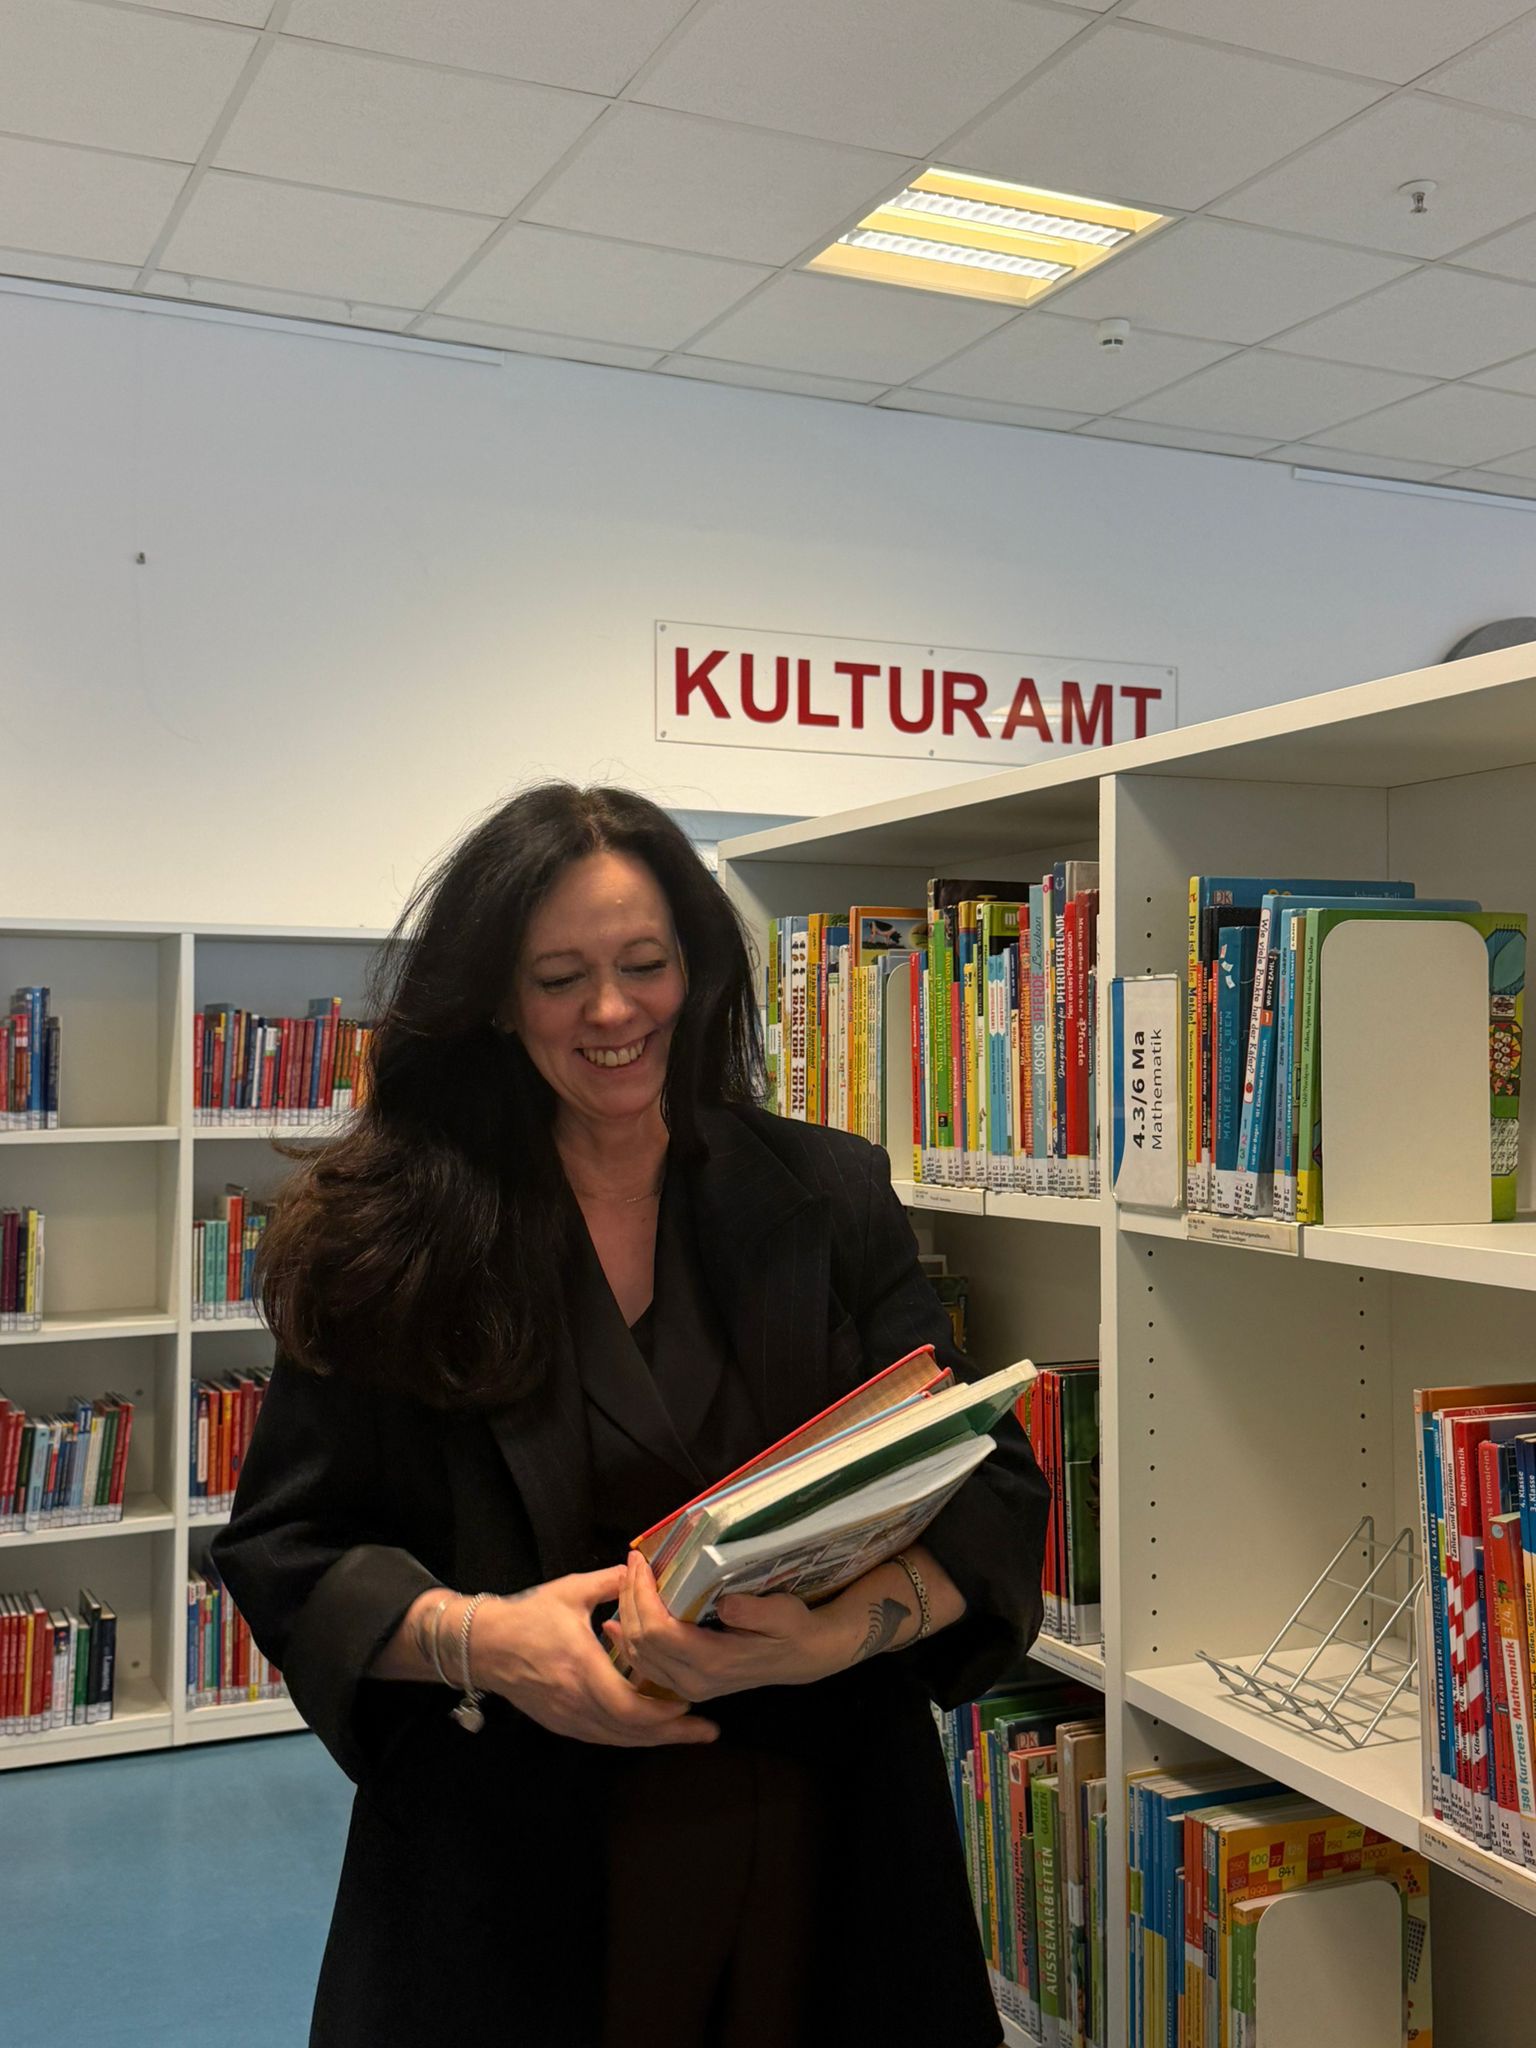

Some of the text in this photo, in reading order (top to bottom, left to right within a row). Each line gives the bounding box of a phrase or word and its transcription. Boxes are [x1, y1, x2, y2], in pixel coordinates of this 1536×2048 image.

[674, 646, 1163, 747] KULTURAMT
[1213, 890, 1233, 905] DK
[1032, 915, 1043, 970] Lexikon
[1188, 915, 1197, 936] Das
[1055, 912, 1066, 1004] PFERDEFREUNDE
[1065, 930, 1073, 975] Pferdebuch
[1188, 958, 1197, 983] alles
[1032, 975, 1045, 1022] PFERDE
[1187, 986, 1197, 1025] Mathe!
[1247, 918, 1269, 1074] Wie viele Punkte hat der Käfer?
[935, 973, 943, 1072] Mein Pferd und ich
[1077, 1017, 1087, 1067] Pferde
[791, 985, 799, 1114] TRAKTOR TOTAL
[1033, 1024, 1046, 1075] KOSMOS
[1131, 1031, 1148, 1150] 4.3/6 Ma
[1150, 1028, 1163, 1150] Mathematik
[1222, 1056, 1232, 1090] FÜRS
[1223, 1095, 1232, 1140] MATHE
[1446, 1463, 1455, 1513] Operationen
[1457, 1446, 1468, 1507] Mathematik
[1517, 1470, 1526, 1508] 4. Klasse
[1528, 1474, 1536, 1512] 3. Klasse
[1449, 1531, 1457, 1559] Zahlen
[1431, 1564, 1443, 1646] MATHEMATIK
[1501, 1607, 1514, 1635] 3./4.
[1525, 1582, 1536, 1664] Größen, Geometrie
[1437, 1648, 1447, 1741] KLASSENARBEITEN
[1505, 1641, 1522, 1720] Mathematik
[1016, 1731, 1039, 1749] DK
[1473, 1720, 1481, 1756] Klasse
[1514, 1723, 1529, 1785] Kurztests
[1039, 1791, 1048, 1834] GARTEN
[1501, 1822, 1509, 1830] 4.3
[1502, 1830, 1510, 1838] Ma
[1250, 1853, 1268, 1868] 100
[1502, 1847, 1516, 1857] DICK
[1523, 1840, 1531, 1848] Ma
[1249, 1884, 1268, 1896] 999
[1278, 1865, 1297, 1879] 841
[1042, 1846, 1058, 1996] AUSSENARBEITEN
